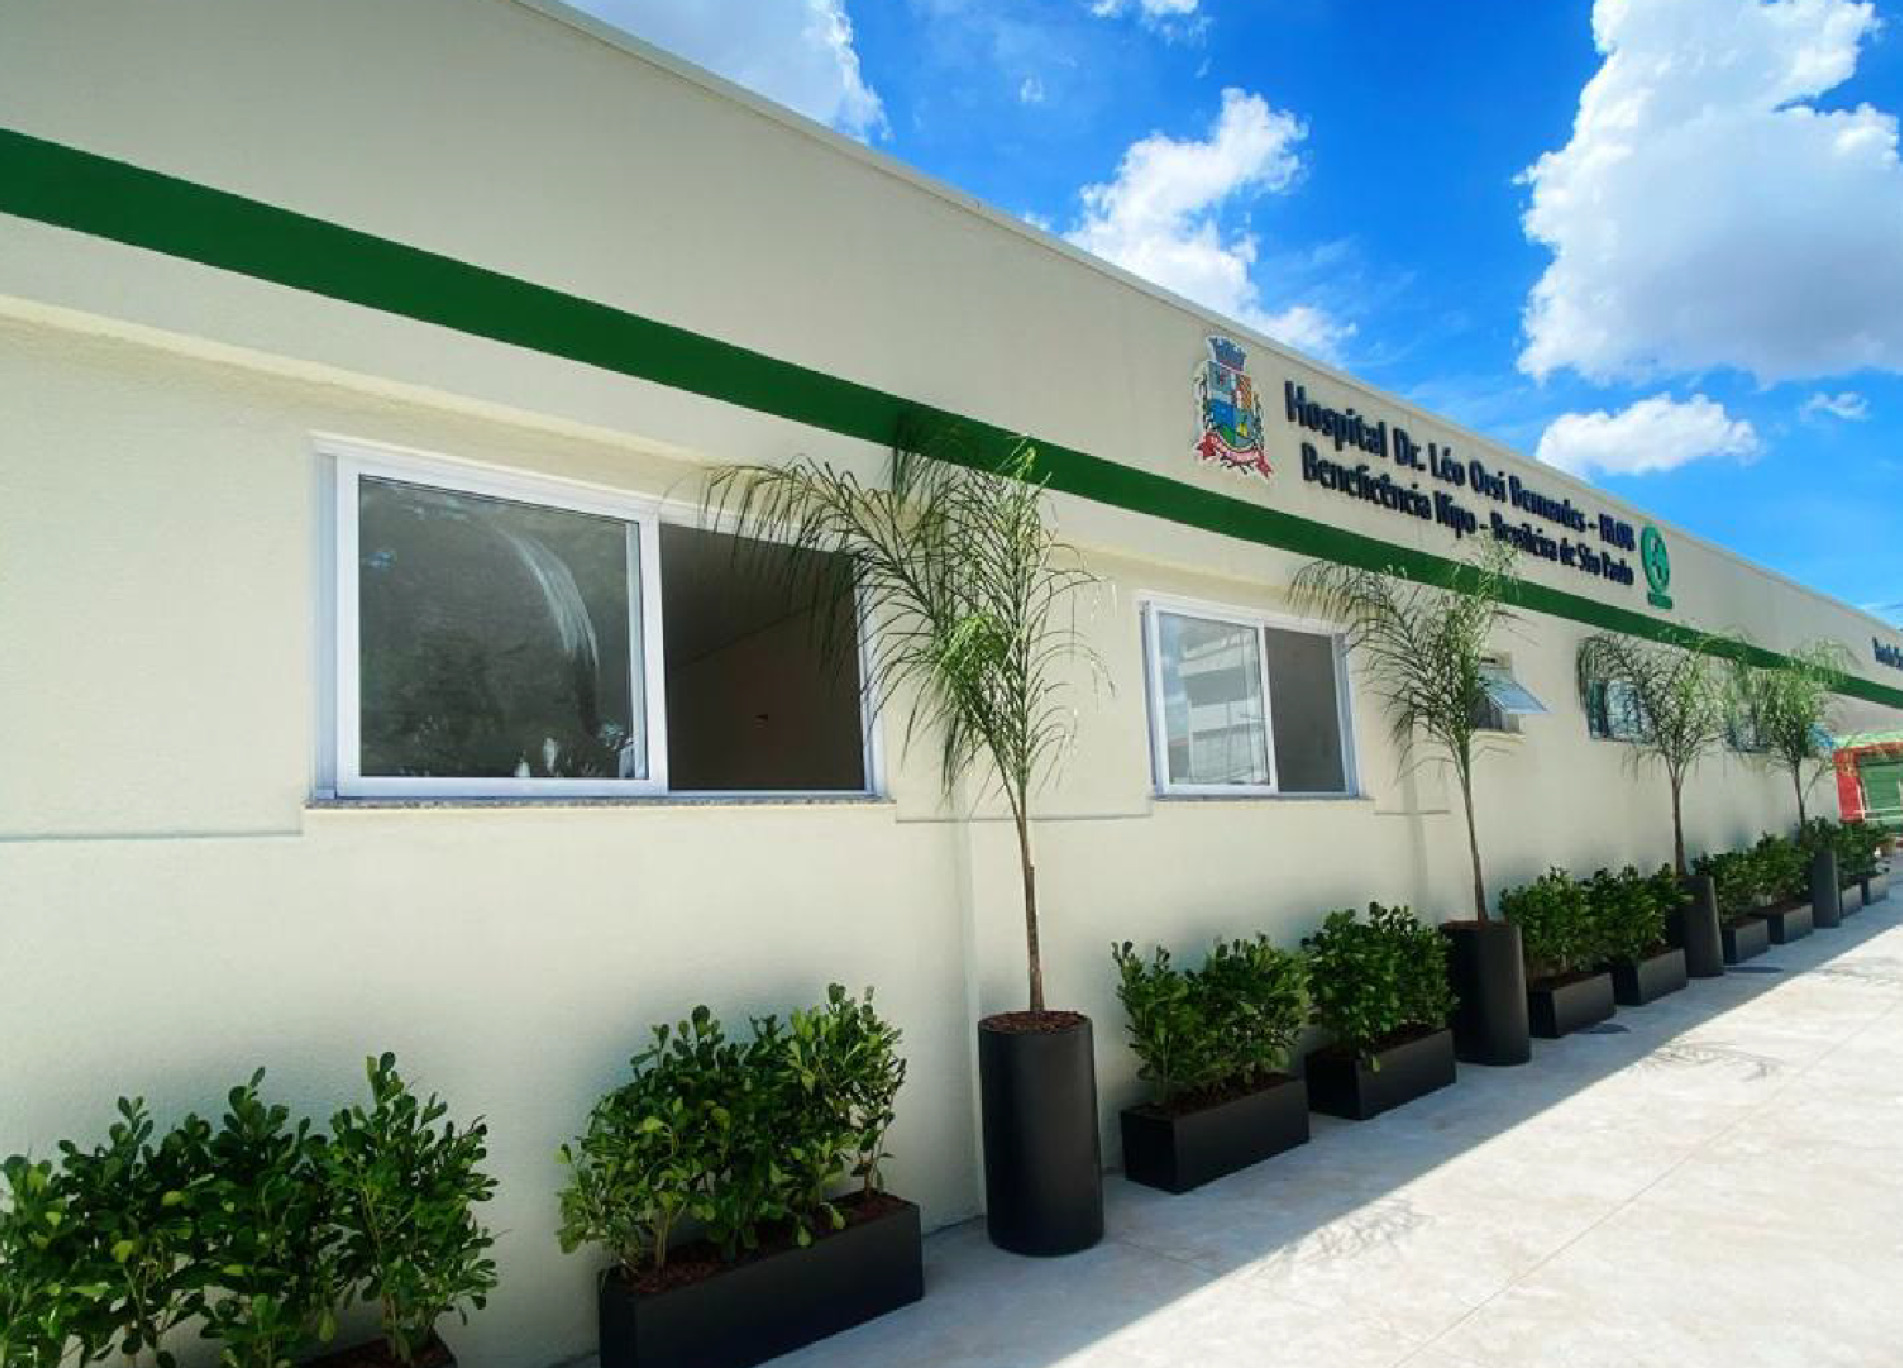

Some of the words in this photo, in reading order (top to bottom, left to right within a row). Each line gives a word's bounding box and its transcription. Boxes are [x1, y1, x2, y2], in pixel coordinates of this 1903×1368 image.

[1284, 380, 1387, 457] Hospital
[1393, 427, 1426, 472] Dr.
[1428, 442, 1465, 486] Léo
[1469, 460, 1505, 504] Orsi
[1301, 442, 1431, 520] Beneficência
[1559, 537, 1576, 567] de
